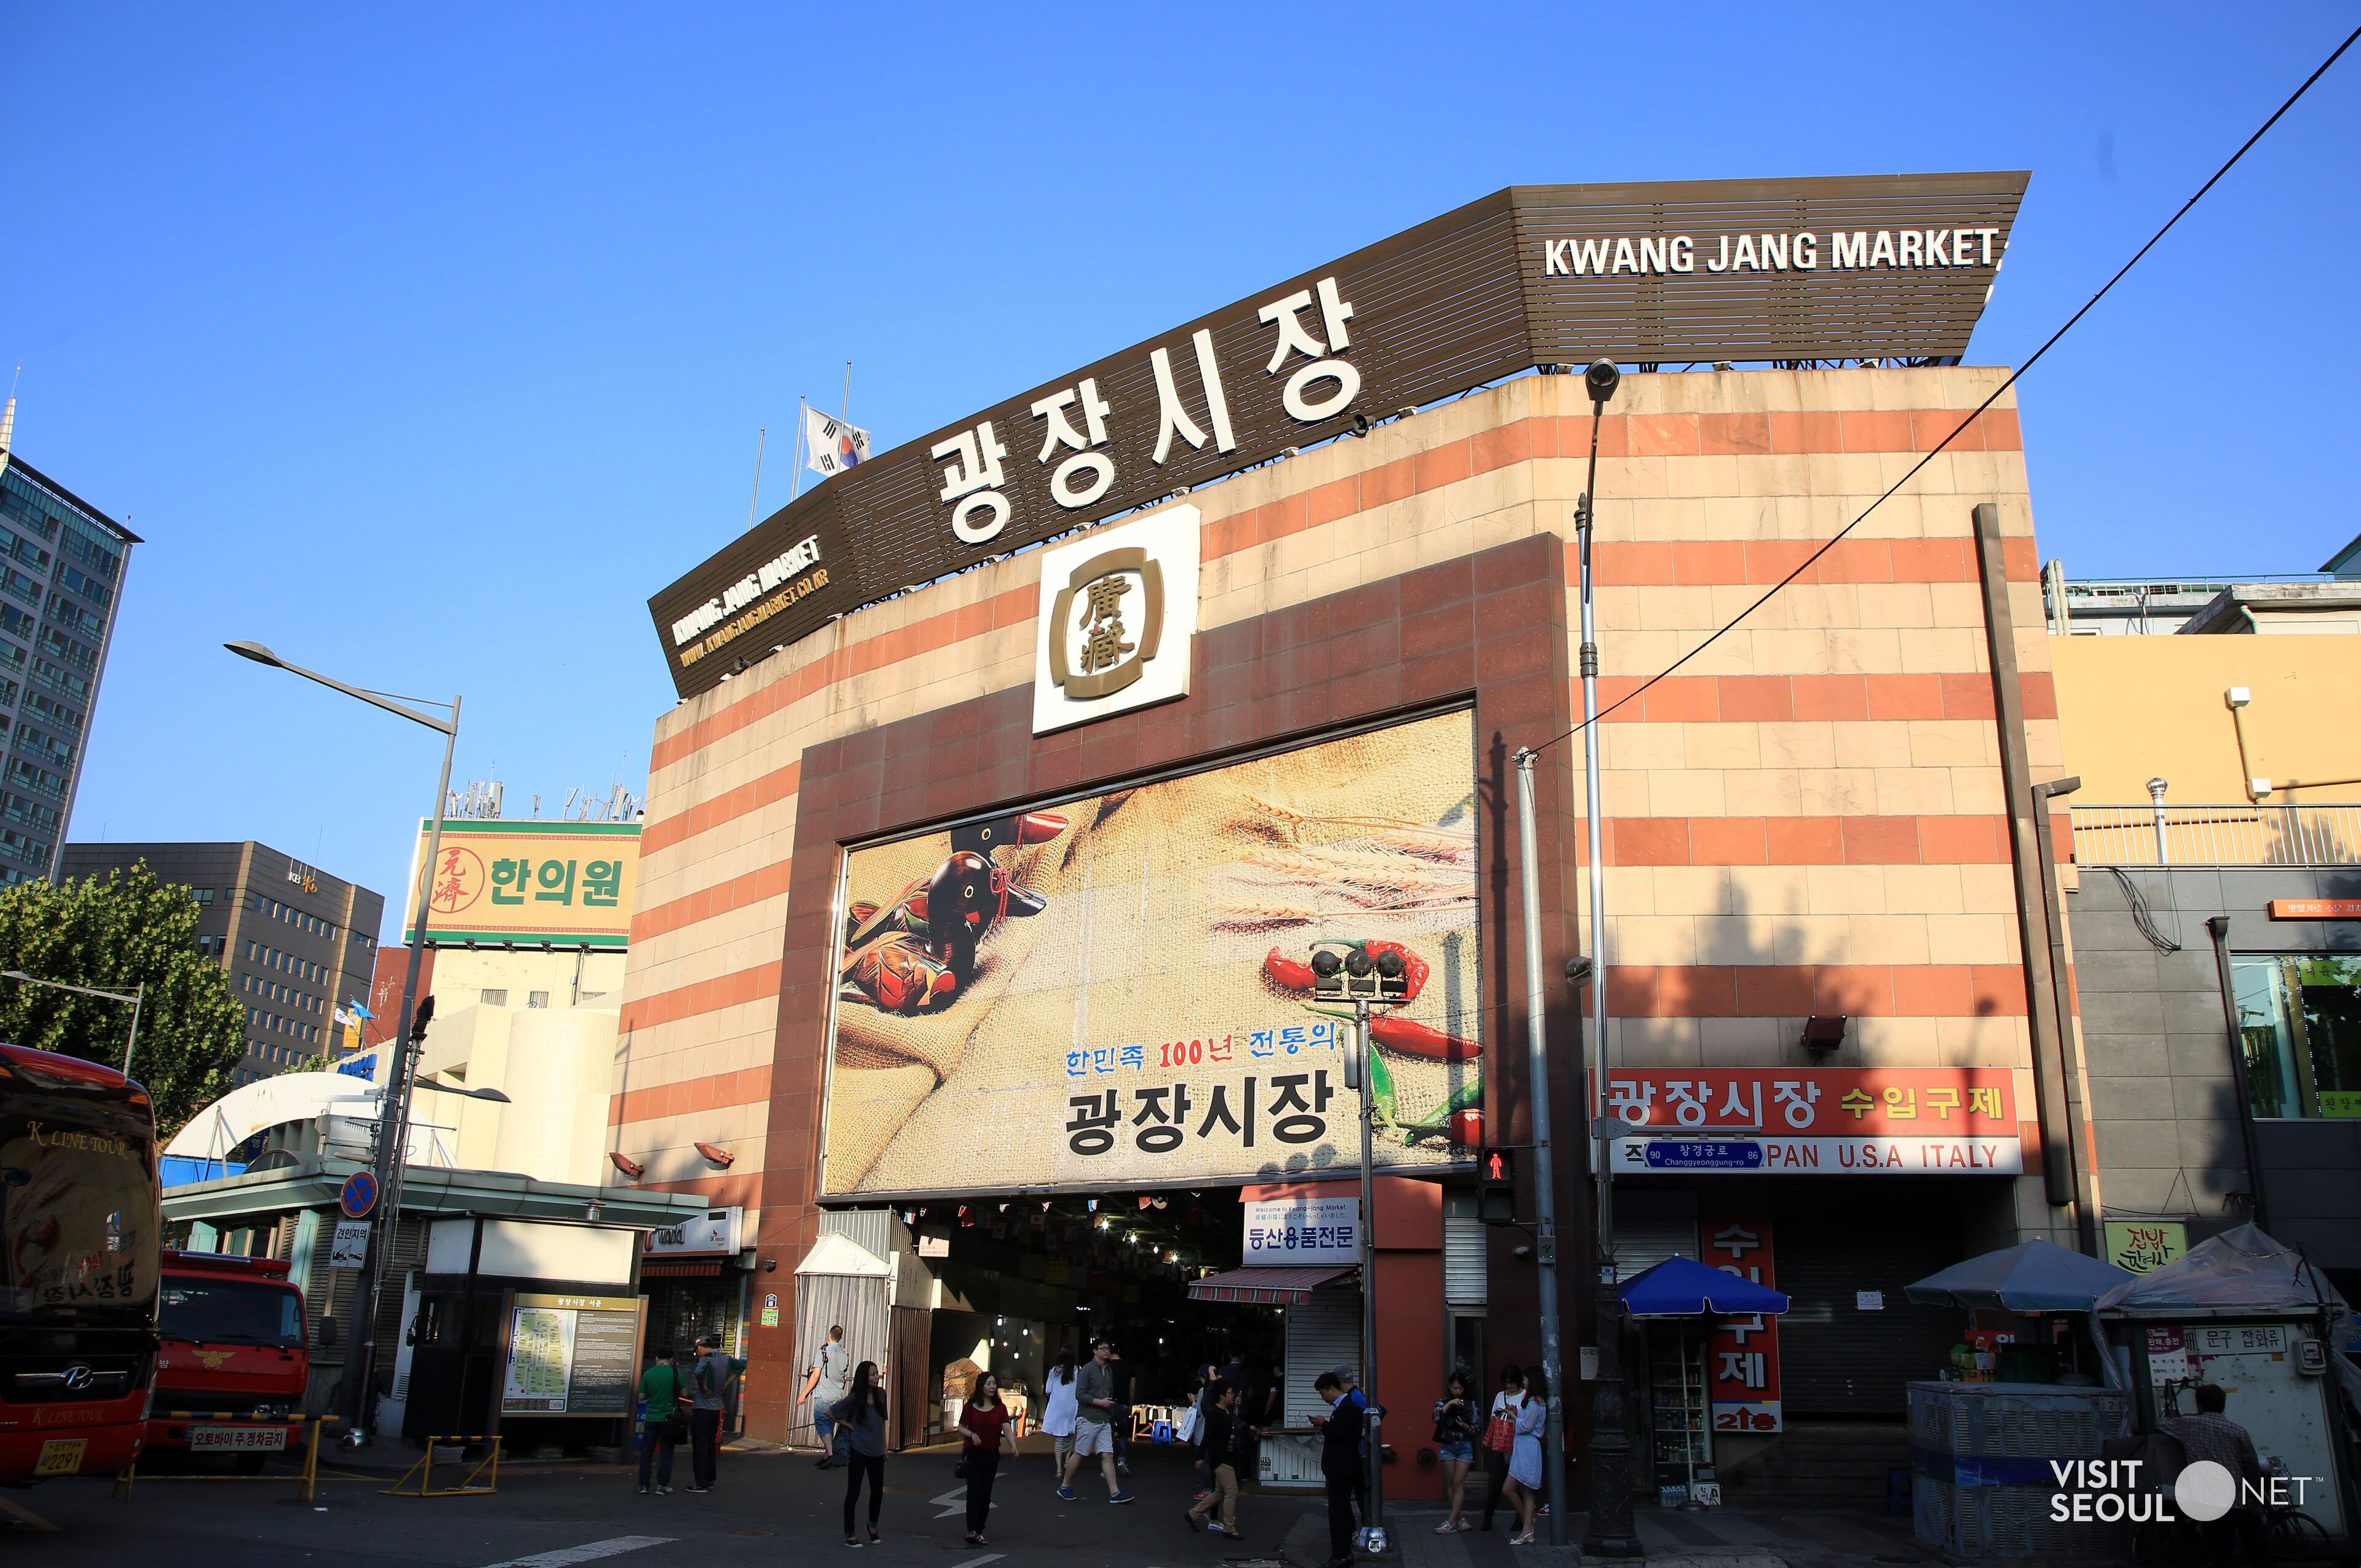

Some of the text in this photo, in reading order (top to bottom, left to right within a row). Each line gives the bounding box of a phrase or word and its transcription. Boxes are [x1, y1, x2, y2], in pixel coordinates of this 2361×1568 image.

[1545, 228, 1999, 276] KWANG JANG MARKET
[930, 276, 1361, 544] 광장시장
[671, 534, 821, 646] KWANG JANG MARKET
[288, 871, 301, 884] KB
[491, 858, 622, 906] 한의원
[1066, 1022, 1337, 1076] 한민족 100년 전통의
[1066, 1070, 1334, 1155] 광장시장
[1609, 1080, 2003, 1128] 광장시장 수입구제
[27, 1121, 128, 1159] K LINE TOUR
[1680, 1144, 1728, 1157] 창경궁로
[1650, 1150, 1660, 1159] 90
[1665, 1158, 1744, 1167] Changgyeonggung-ro
[1922, 1144, 1997, 1167] ITALY
[338, 1229, 368, 1240] 견인지역
[1249, 1226, 1353, 1250] 등산용품전문
[2127, 1228, 2169, 1250] 집밥
[558, 1297, 585, 1307] 광장시장
[2206, 1331, 2231, 1348] 문구
[2241, 1328, 2279, 1348] 잡화류
[32, 1408, 45, 1427] K
[48, 1410, 76, 1423] LINE
[77, 1409, 104, 1422] TOUR
[194, 1432, 233, 1446] 오토바이
